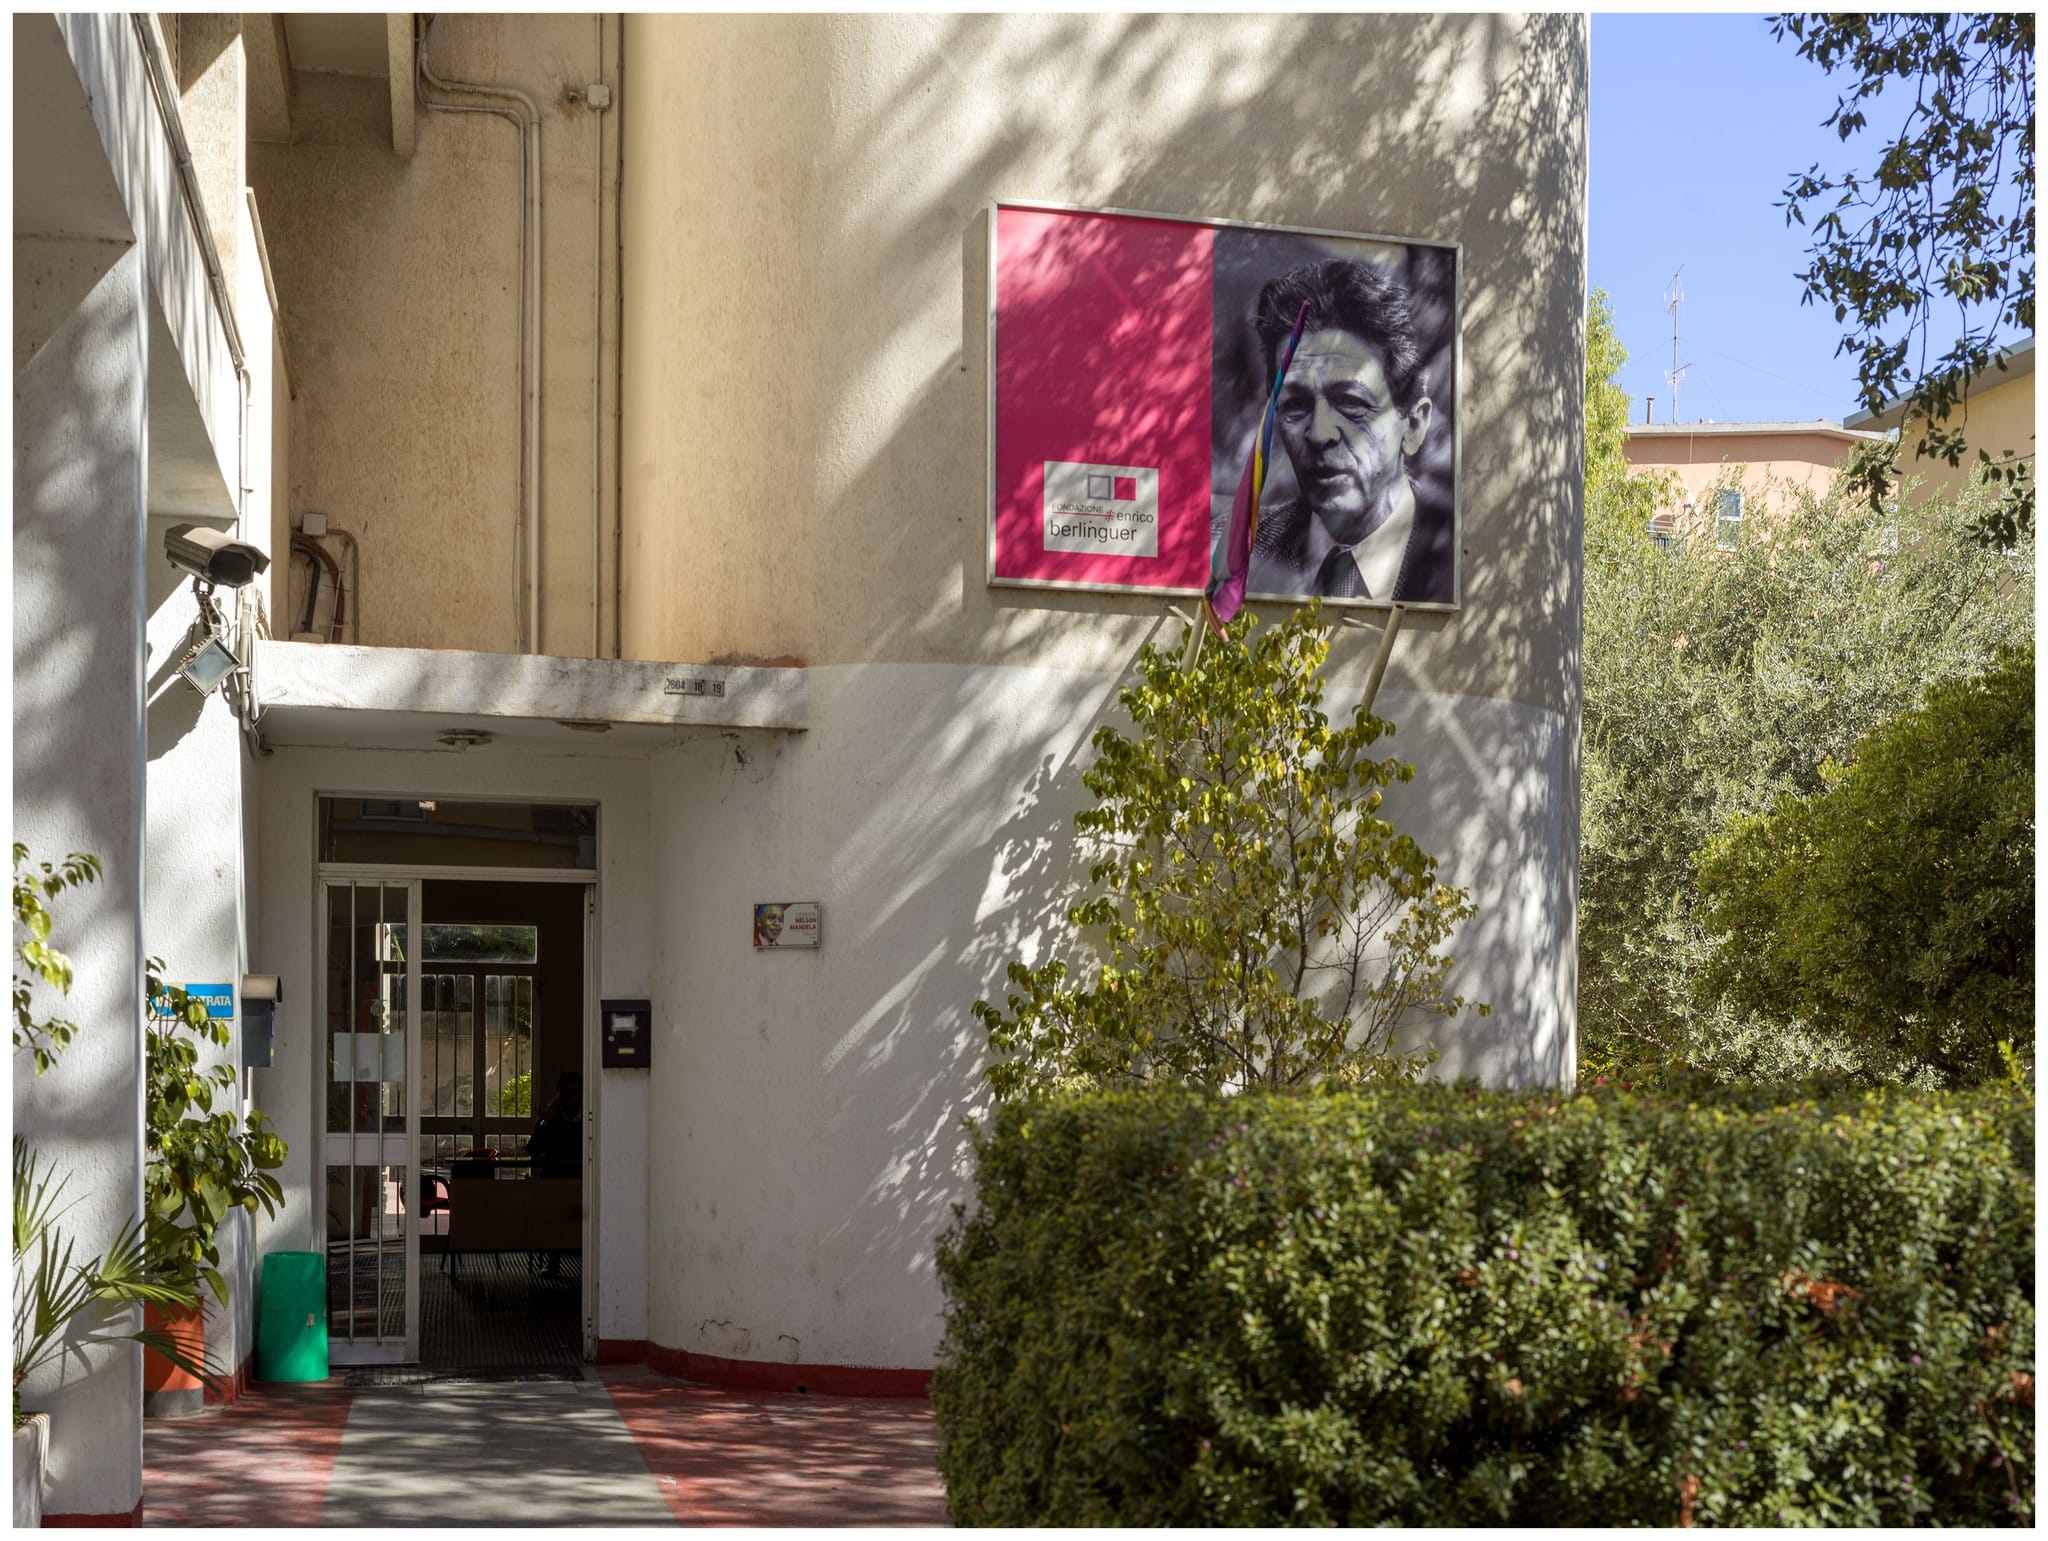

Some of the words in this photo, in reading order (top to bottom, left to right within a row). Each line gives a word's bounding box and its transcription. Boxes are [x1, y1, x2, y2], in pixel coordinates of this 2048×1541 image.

[1052, 503, 1104, 513] FONDAZIONE
[1116, 510, 1154, 523] enrico
[1050, 520, 1137, 543] berlinguer
